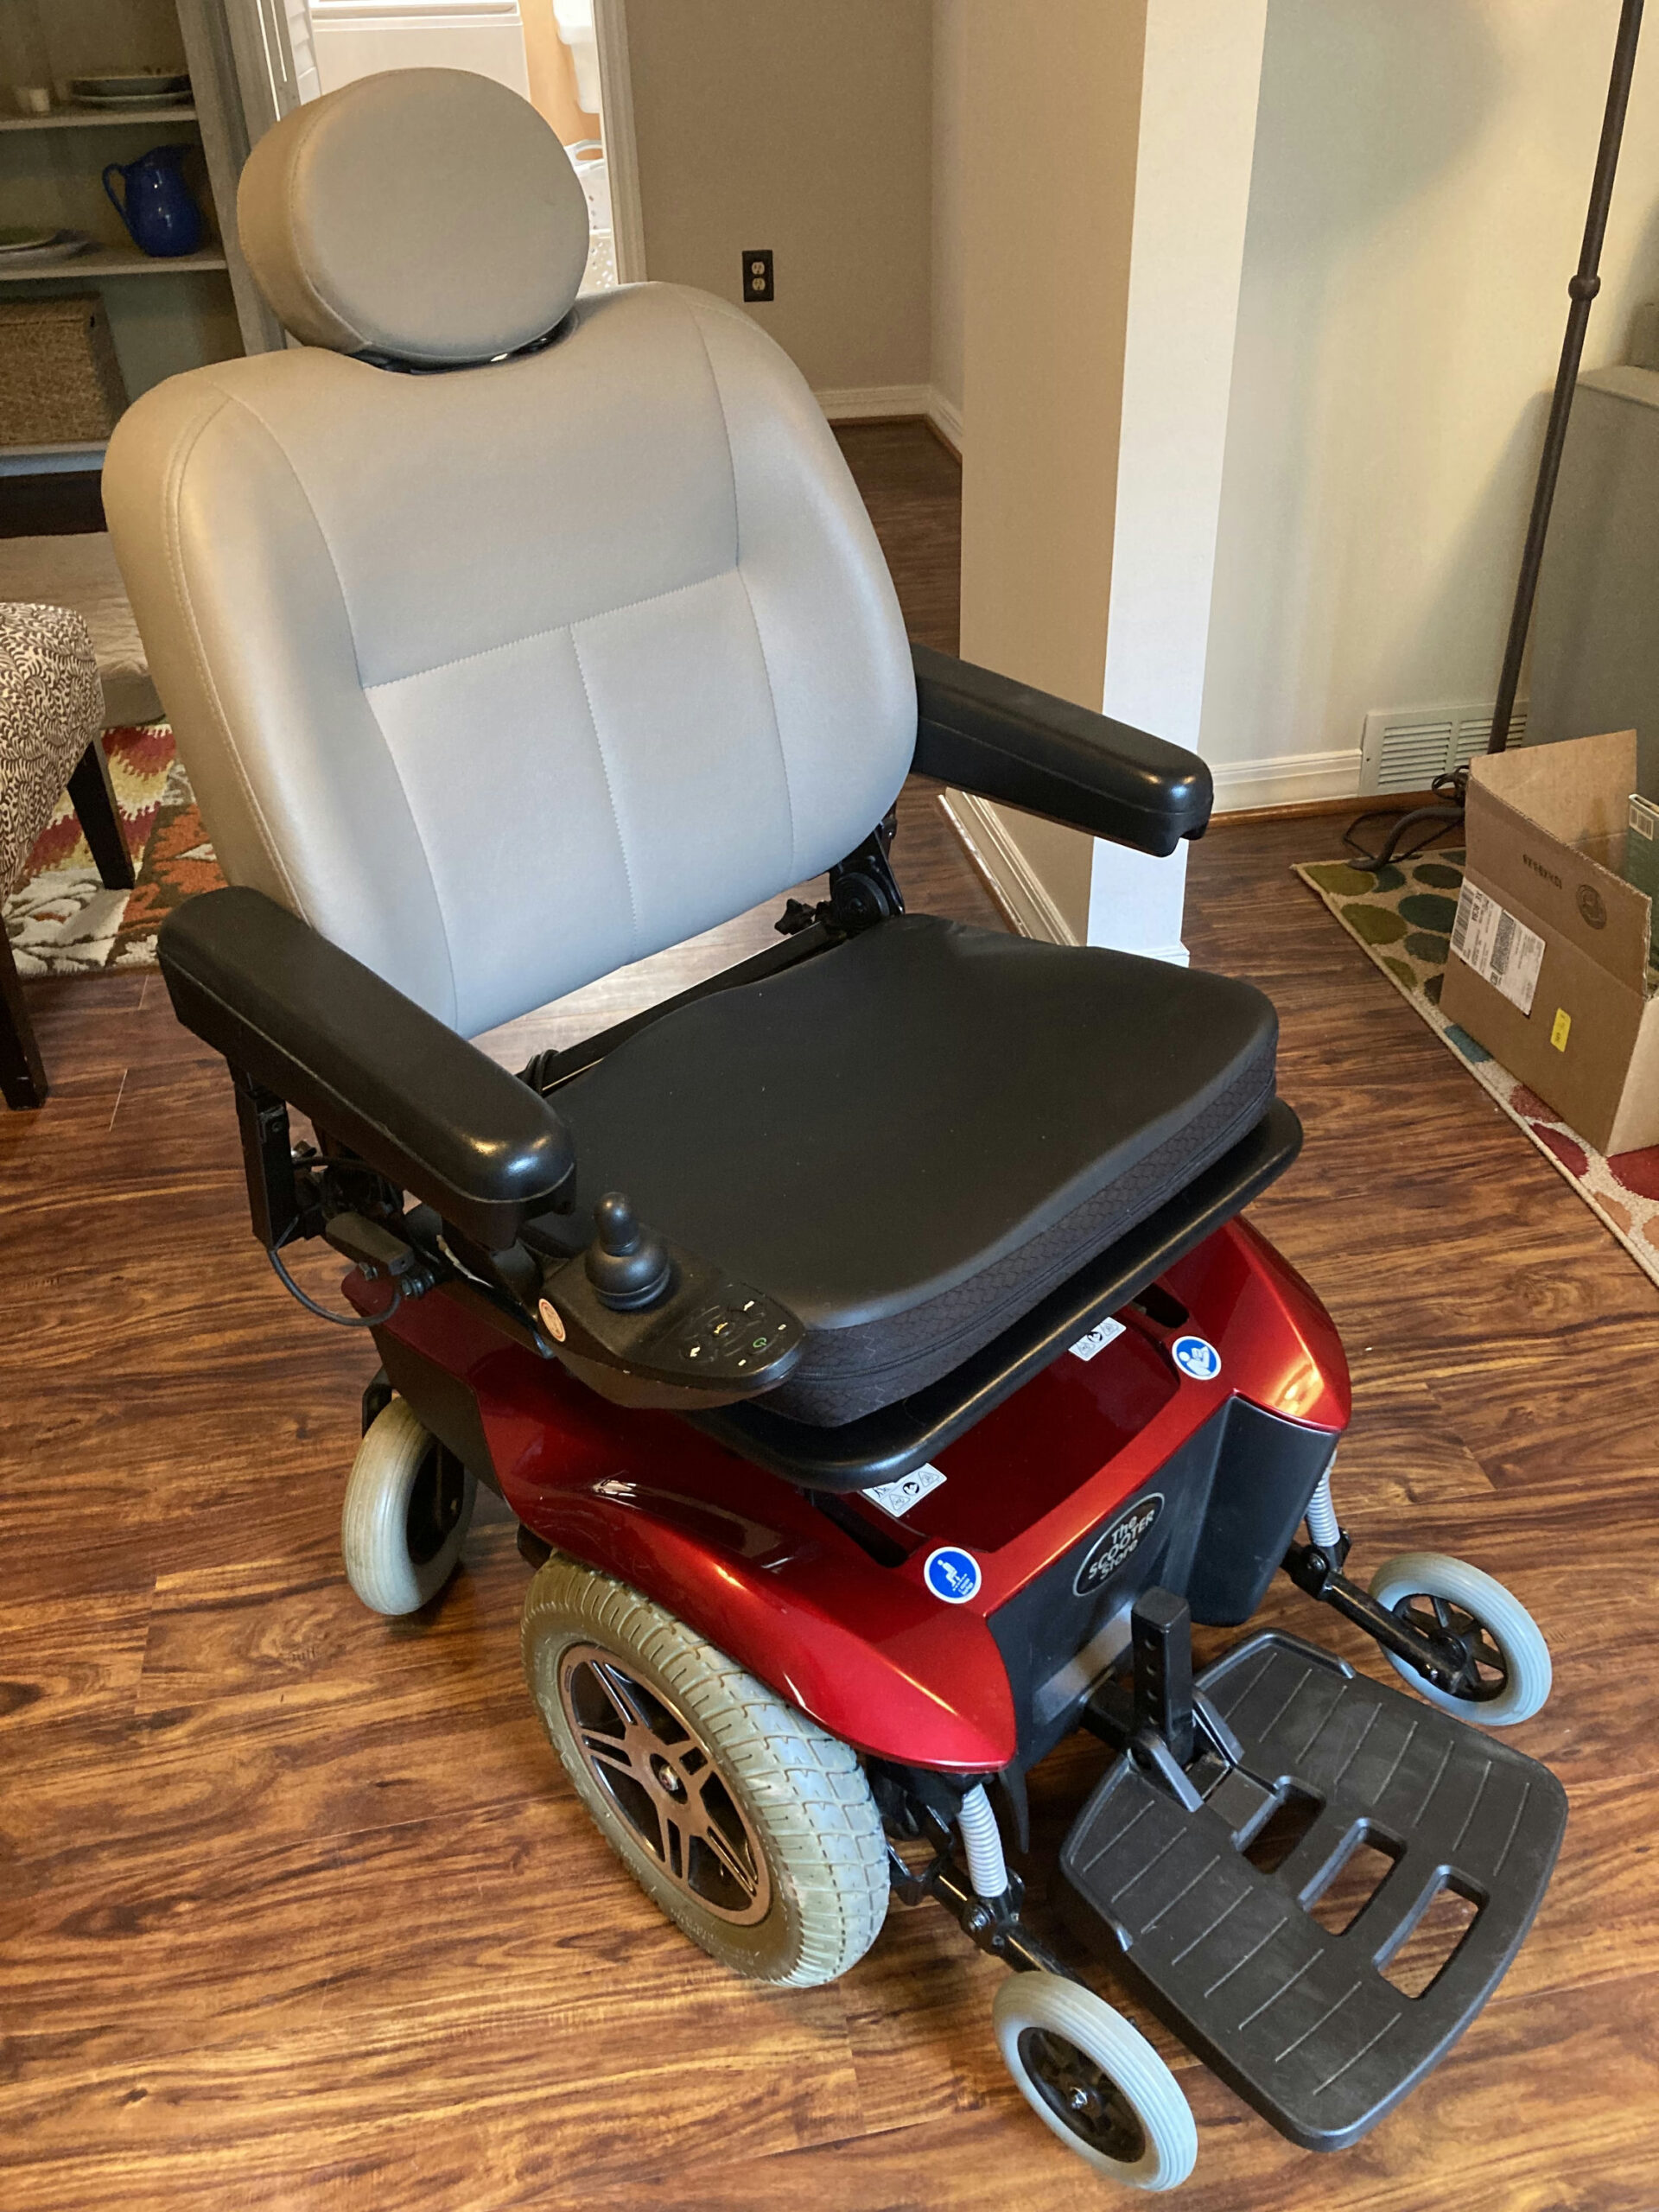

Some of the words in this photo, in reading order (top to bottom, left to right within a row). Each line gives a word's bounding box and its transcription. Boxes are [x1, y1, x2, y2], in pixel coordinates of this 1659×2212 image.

[1088, 1509, 1155, 1580] SCOOTER
[1111, 1516, 1137, 1544] The
[1100, 1539, 1138, 1580] Store
